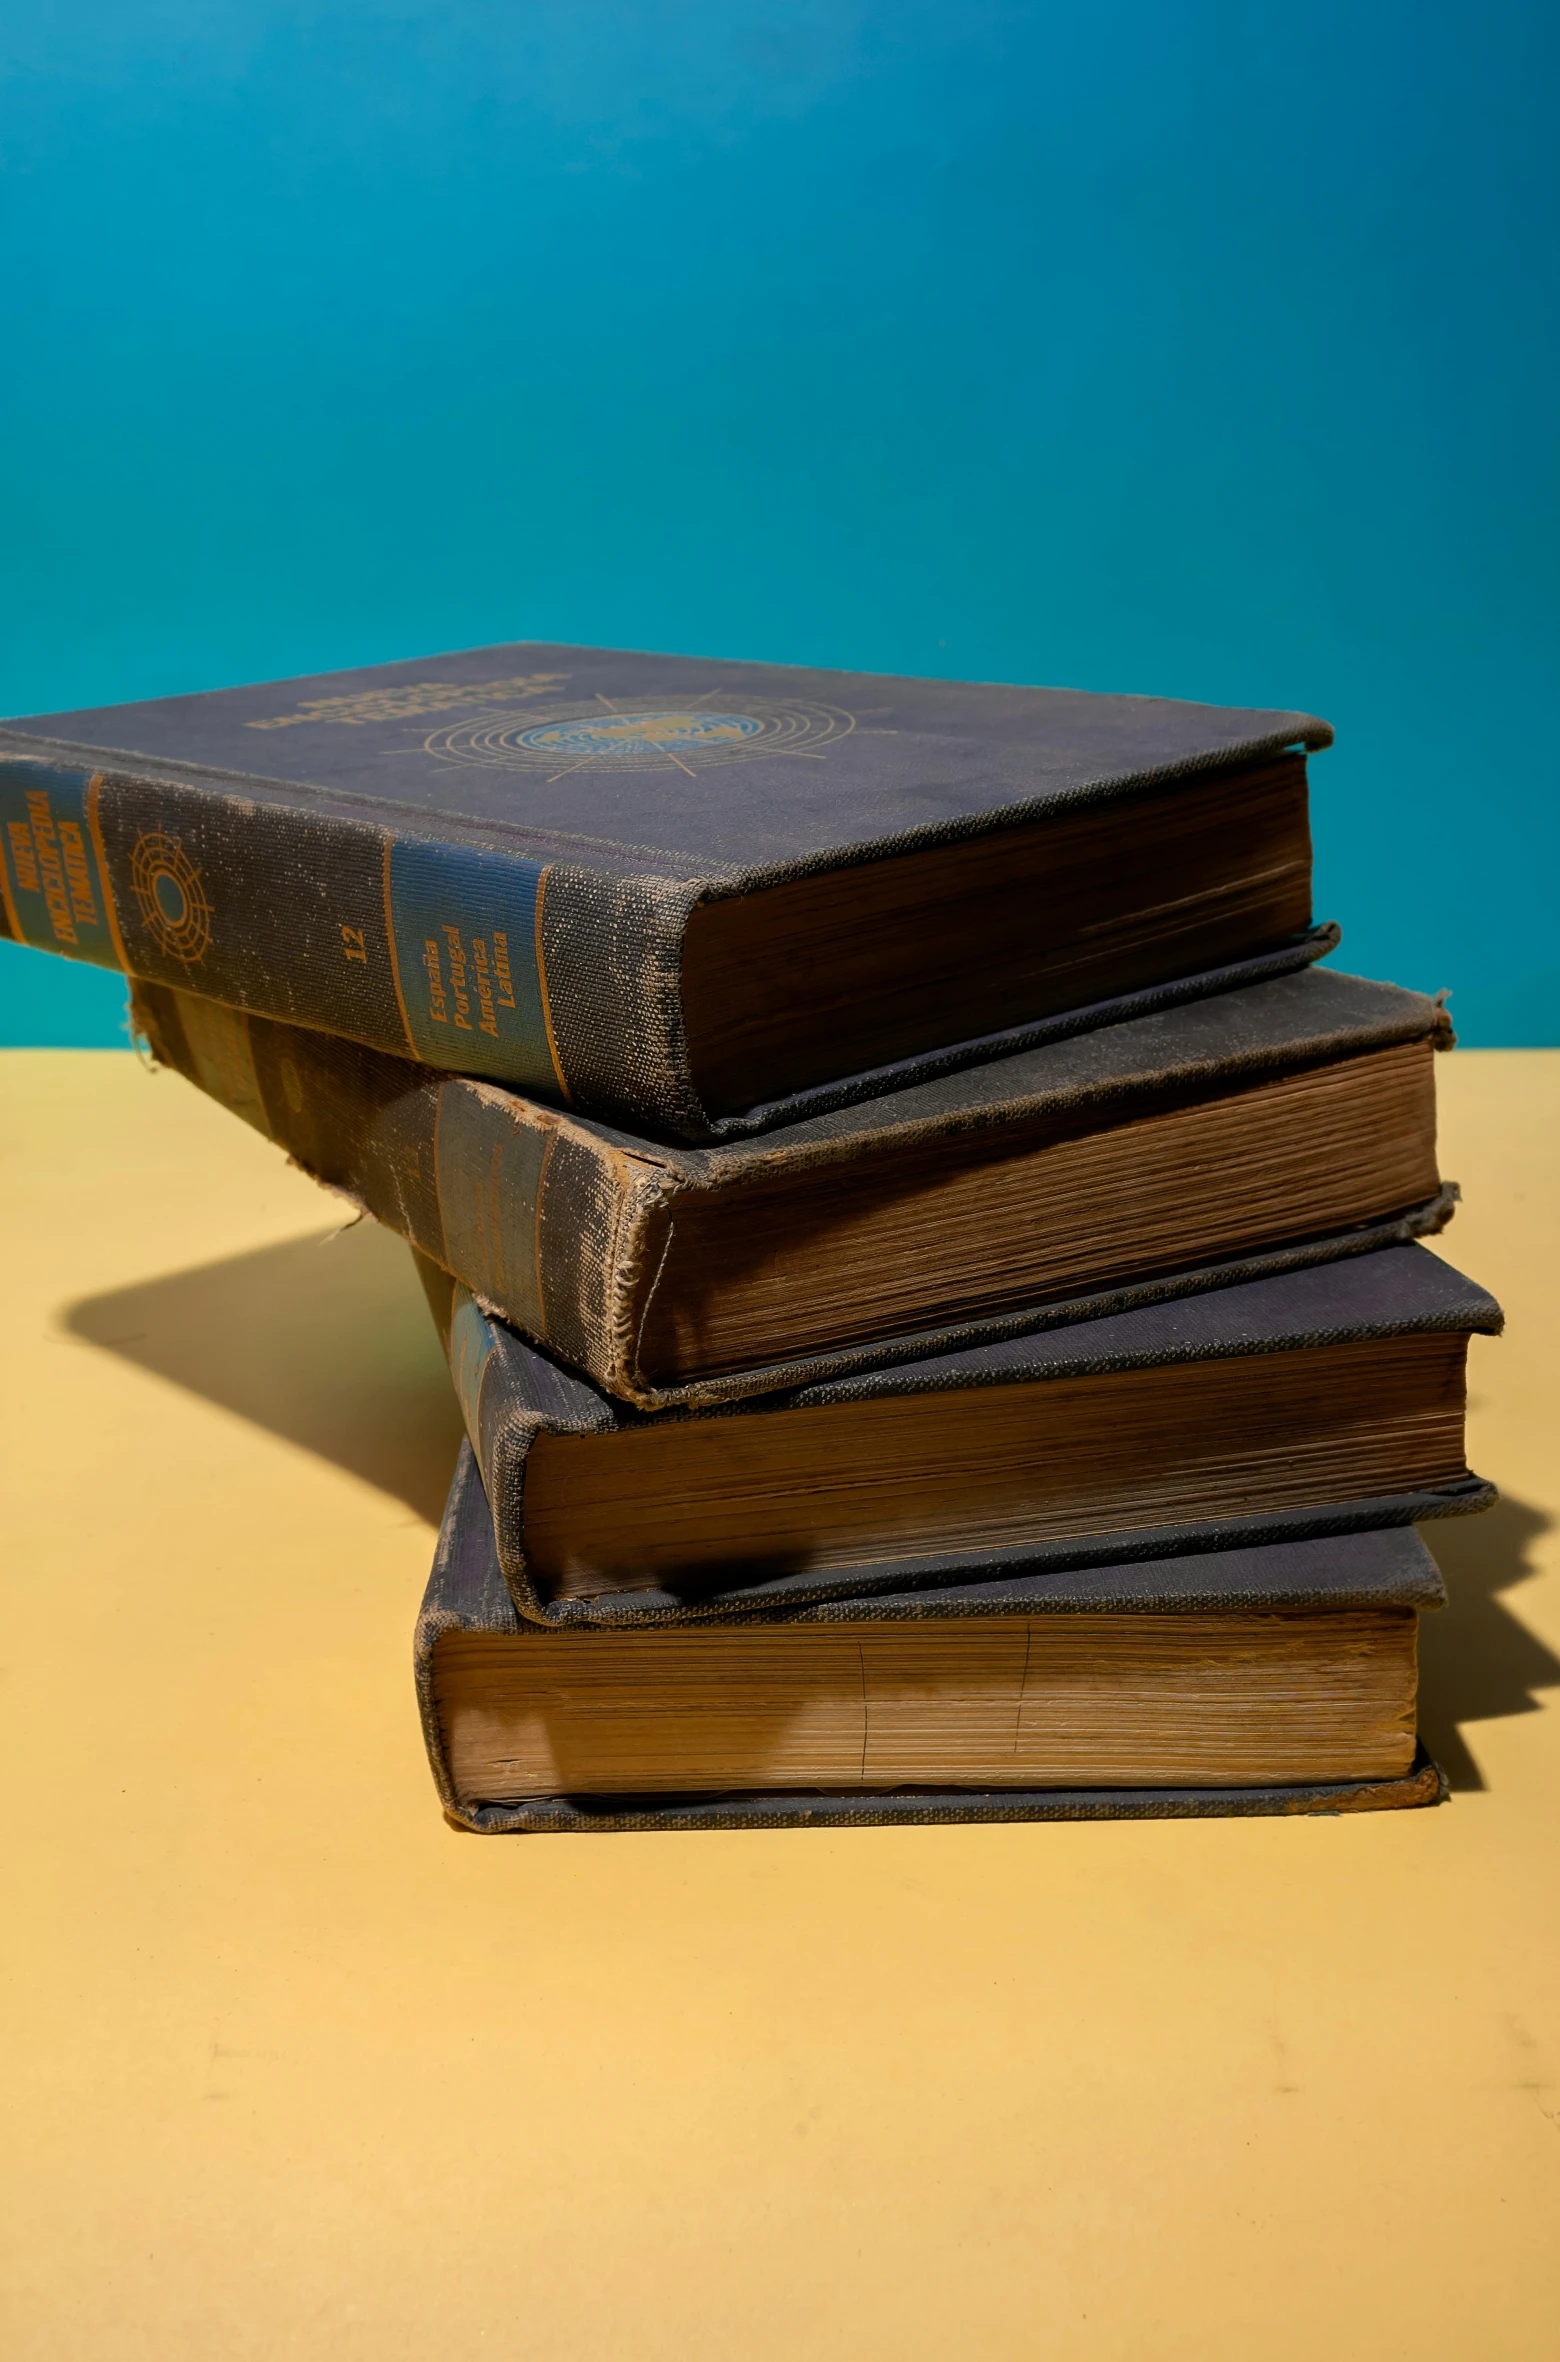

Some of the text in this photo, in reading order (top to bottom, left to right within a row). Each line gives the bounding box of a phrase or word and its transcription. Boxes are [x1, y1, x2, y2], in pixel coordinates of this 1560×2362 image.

[7, 821, 41, 893] NUEVA
[25, 791, 78, 944] ENCICLOPEDIA
[57, 821, 98, 925] TEMATICA
[341, 925, 368, 964] 12
[422, 940, 448, 1023] España
[441, 925, 473, 1030] Portugal
[472, 938, 498, 1038] América
[493, 932, 516, 1009] Latina
